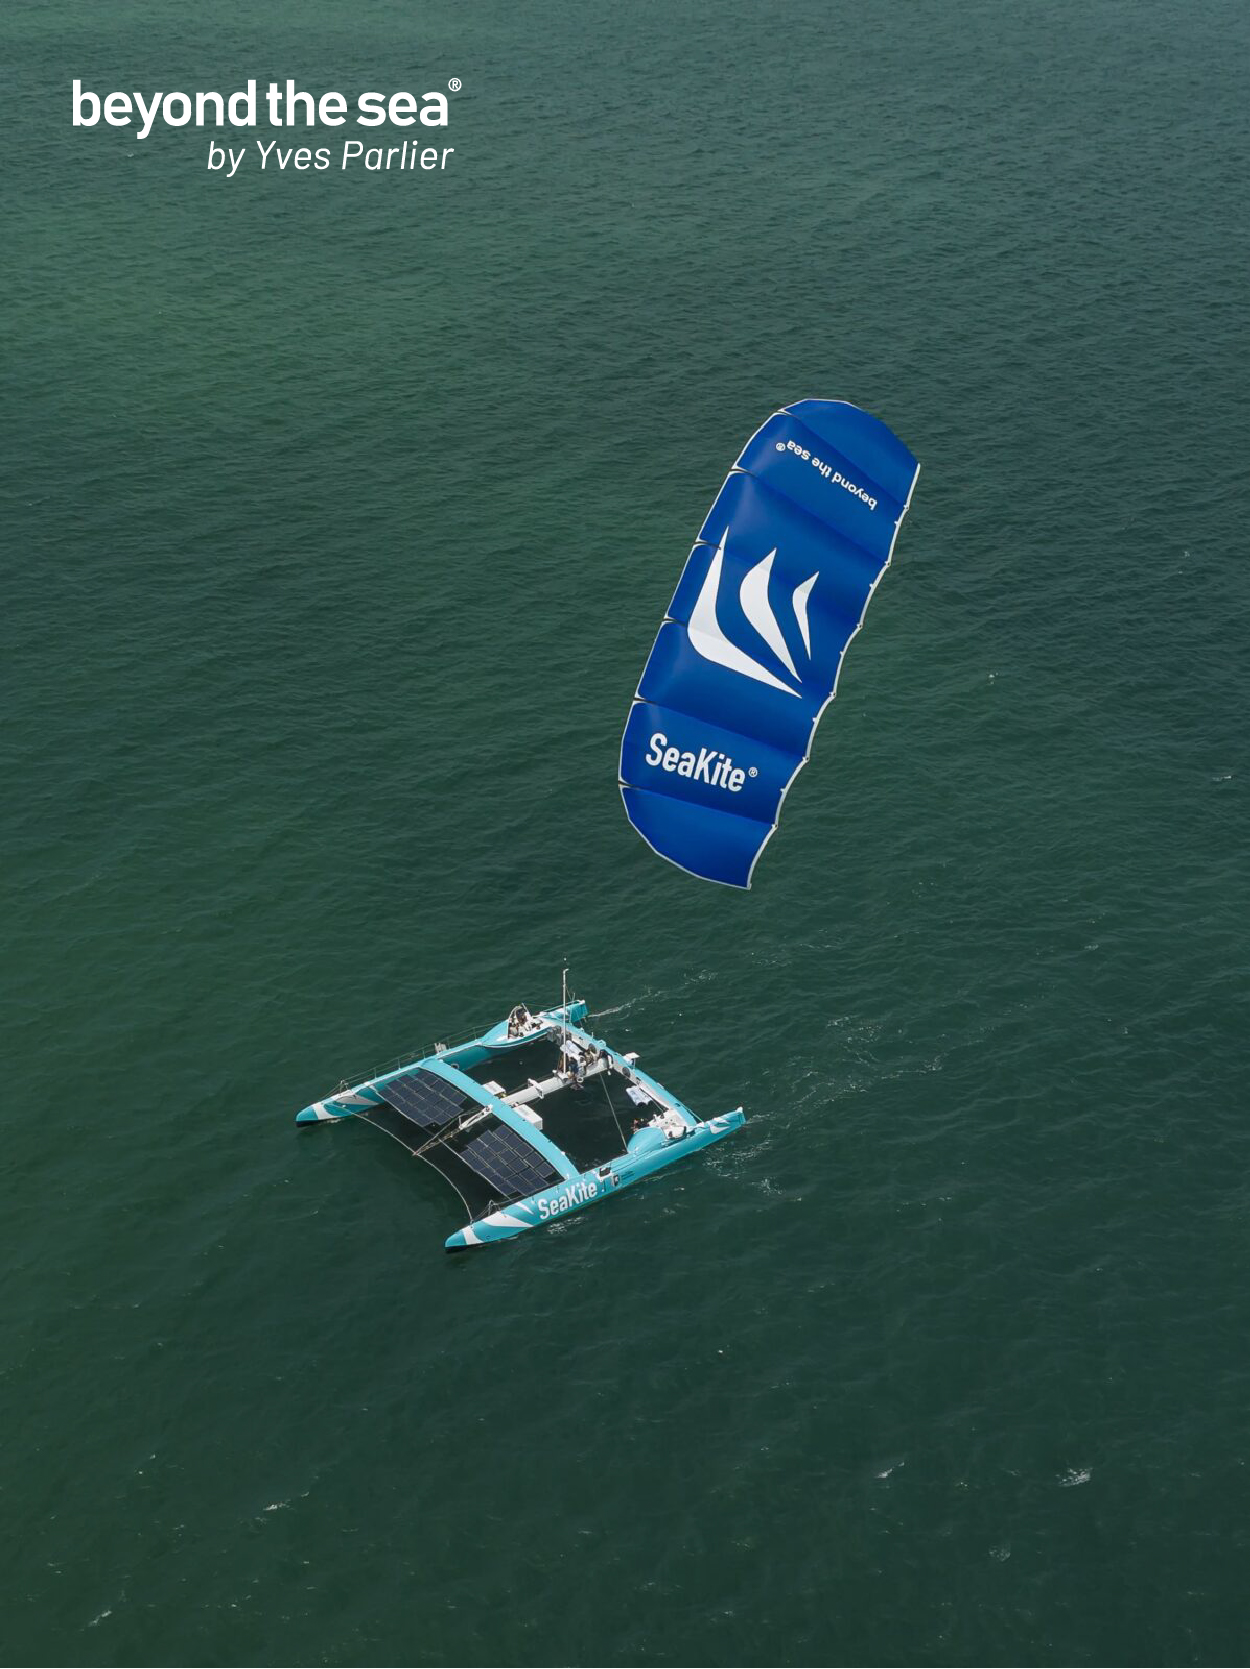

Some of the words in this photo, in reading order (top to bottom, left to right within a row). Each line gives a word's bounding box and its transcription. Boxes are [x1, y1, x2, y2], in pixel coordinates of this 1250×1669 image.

[811, 457, 833, 478] the
[831, 471, 878, 511] beyond
[537, 1181, 598, 1220] SeaKite
